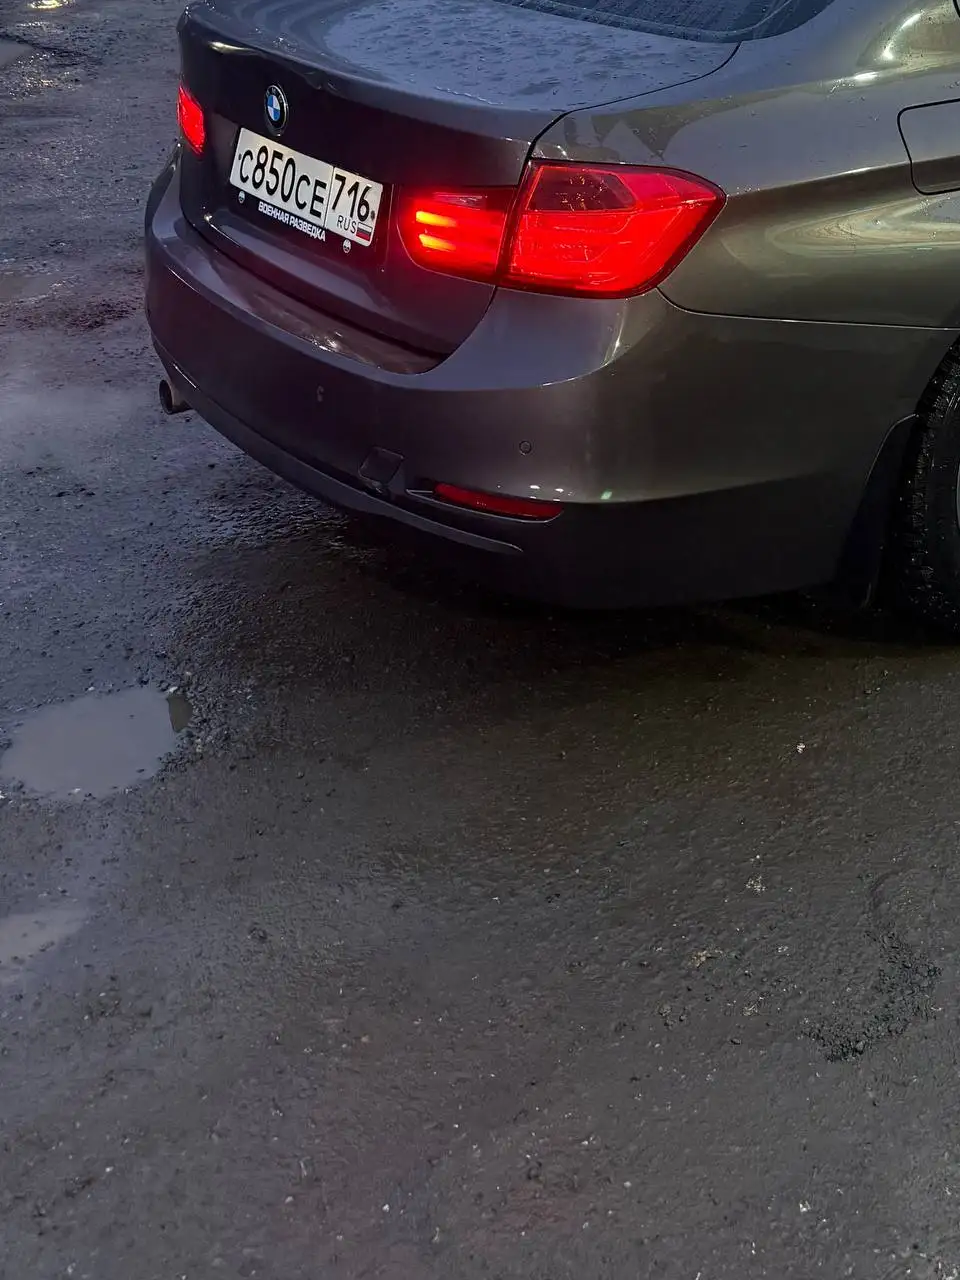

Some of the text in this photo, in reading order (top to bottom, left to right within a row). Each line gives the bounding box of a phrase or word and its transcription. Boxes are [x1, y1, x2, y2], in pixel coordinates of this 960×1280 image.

[239, 145, 372, 222] С850СЕ 716
[258, 201, 326, 242] ВОЕННАЯ РАЗВЕДКА
[336, 215, 357, 235] RUS
